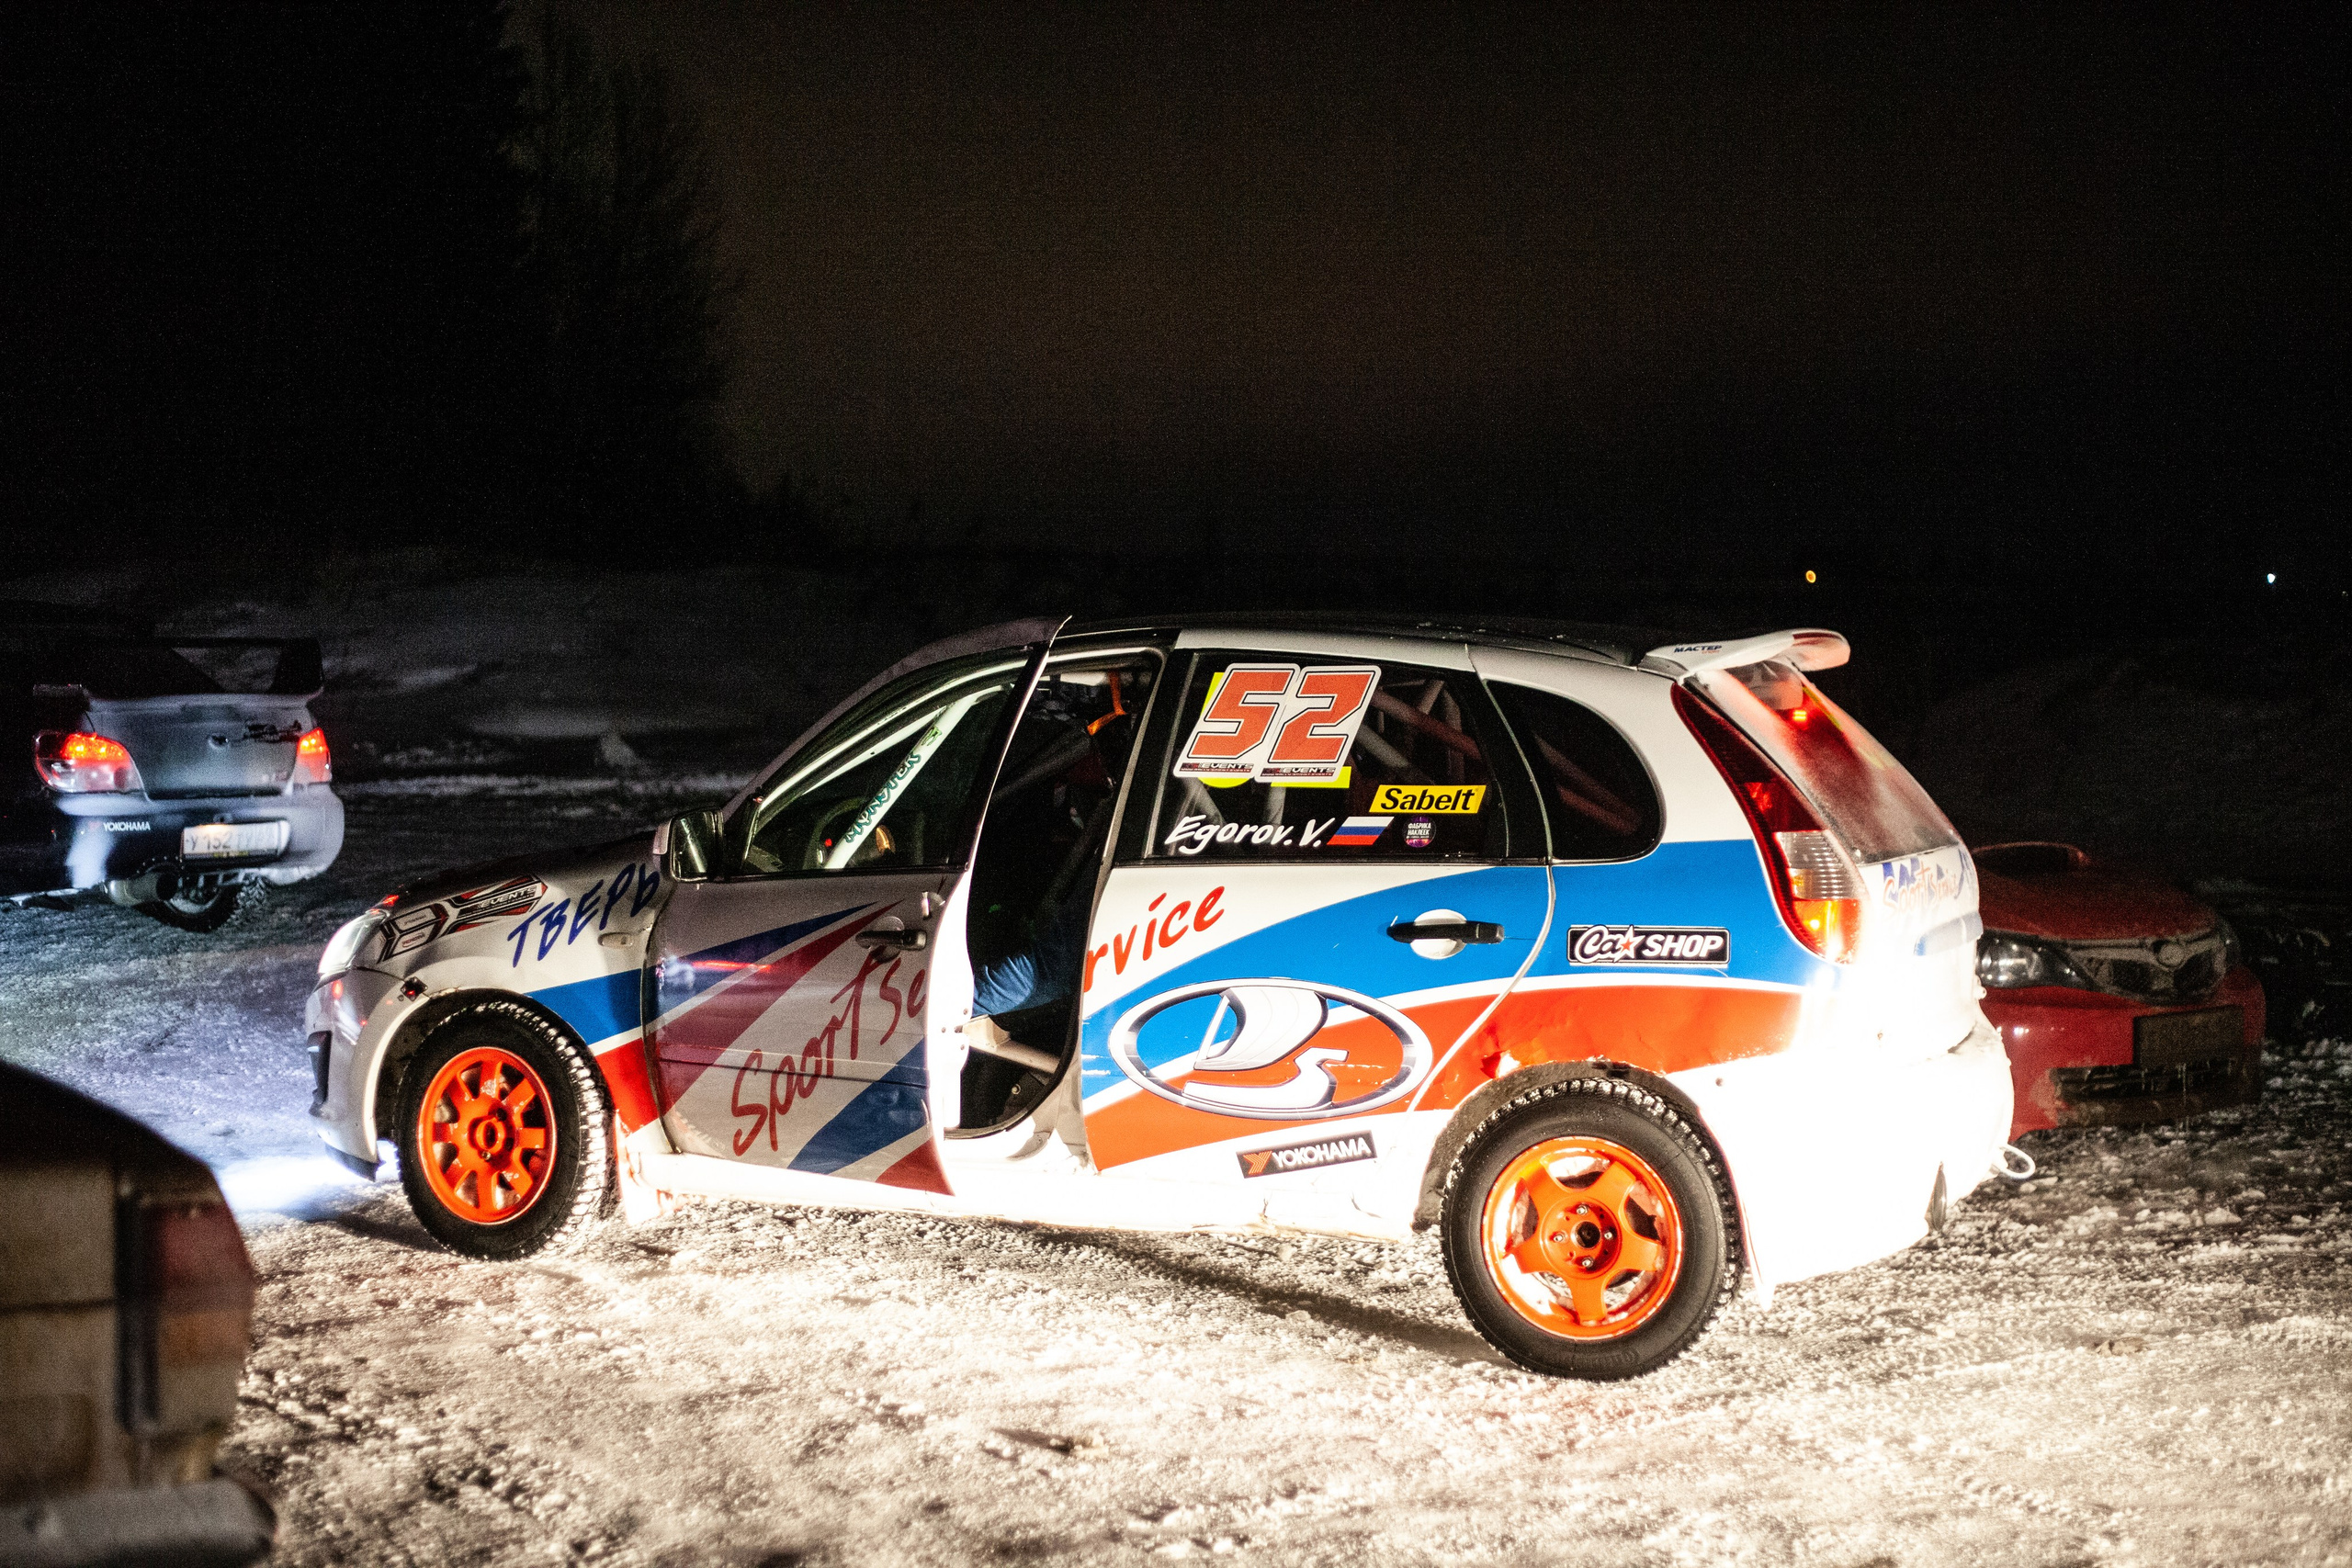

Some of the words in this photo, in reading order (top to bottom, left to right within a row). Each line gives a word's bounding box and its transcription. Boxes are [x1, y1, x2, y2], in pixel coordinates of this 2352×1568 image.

[1188, 670, 1376, 763] 52
[1380, 786, 1476, 811] Sabelt
[103, 821, 151, 832] YOKOHAMA
[506, 863, 662, 968] ТВЕРЬ
[1641, 934, 1724, 958] SHOP
[1271, 1136, 1372, 1169] YOKOHAMA
